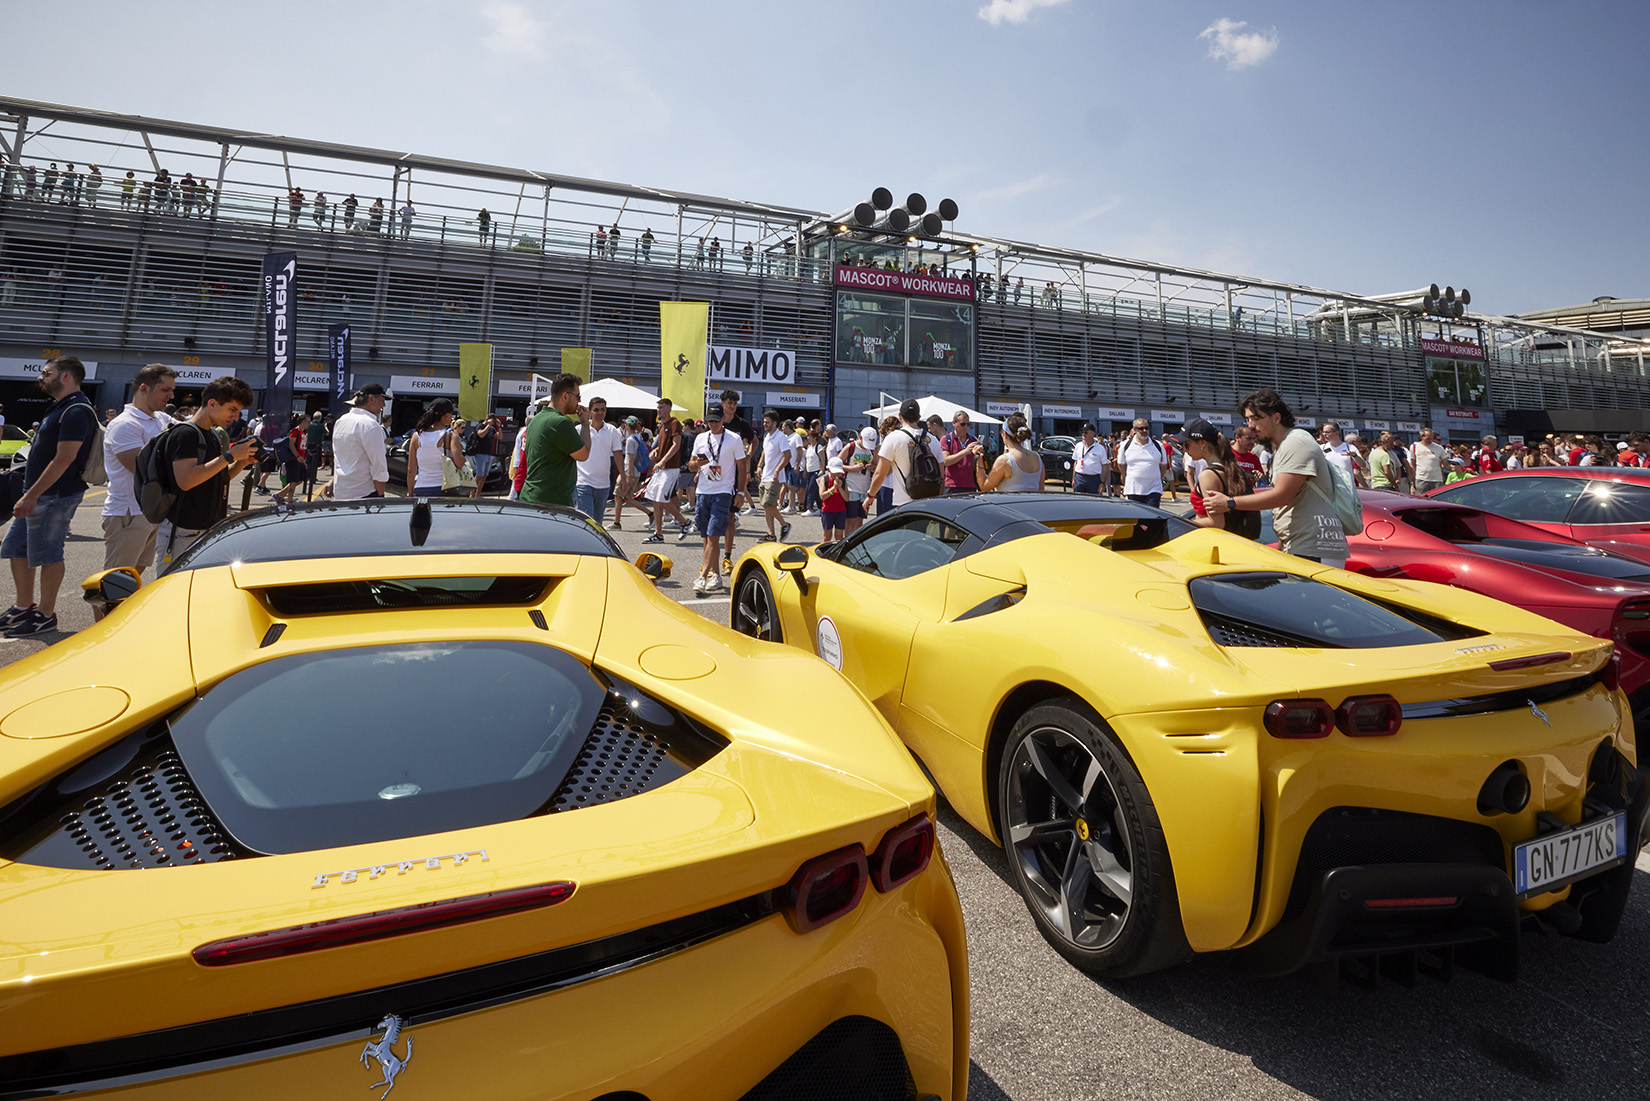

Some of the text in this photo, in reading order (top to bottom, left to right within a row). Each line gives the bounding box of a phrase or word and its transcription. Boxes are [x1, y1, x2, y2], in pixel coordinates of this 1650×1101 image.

[839, 270, 970, 296] MASCOT® WORKWEAR
[863, 336, 882, 346] MONZA
[863, 345, 875, 354] 100
[932, 342, 951, 351] MONZA
[1450, 345, 1482, 357] WORKWEAR
[41, 348, 60, 358] 28
[933, 350, 944, 359] 100
[183, 355, 200, 365] 29
[706, 347, 790, 381] MIMO
[308, 362, 324, 371] 30
[177, 370, 212, 379] CLAREN
[421, 367, 434, 376] 31
[526, 373, 532, 381] 3
[411, 380, 444, 389] FERRARI
[518, 384, 547, 393] FERARI
[1119, 784, 1150, 883] MICHELIN
[1530, 823, 1614, 883] GN 777KS
